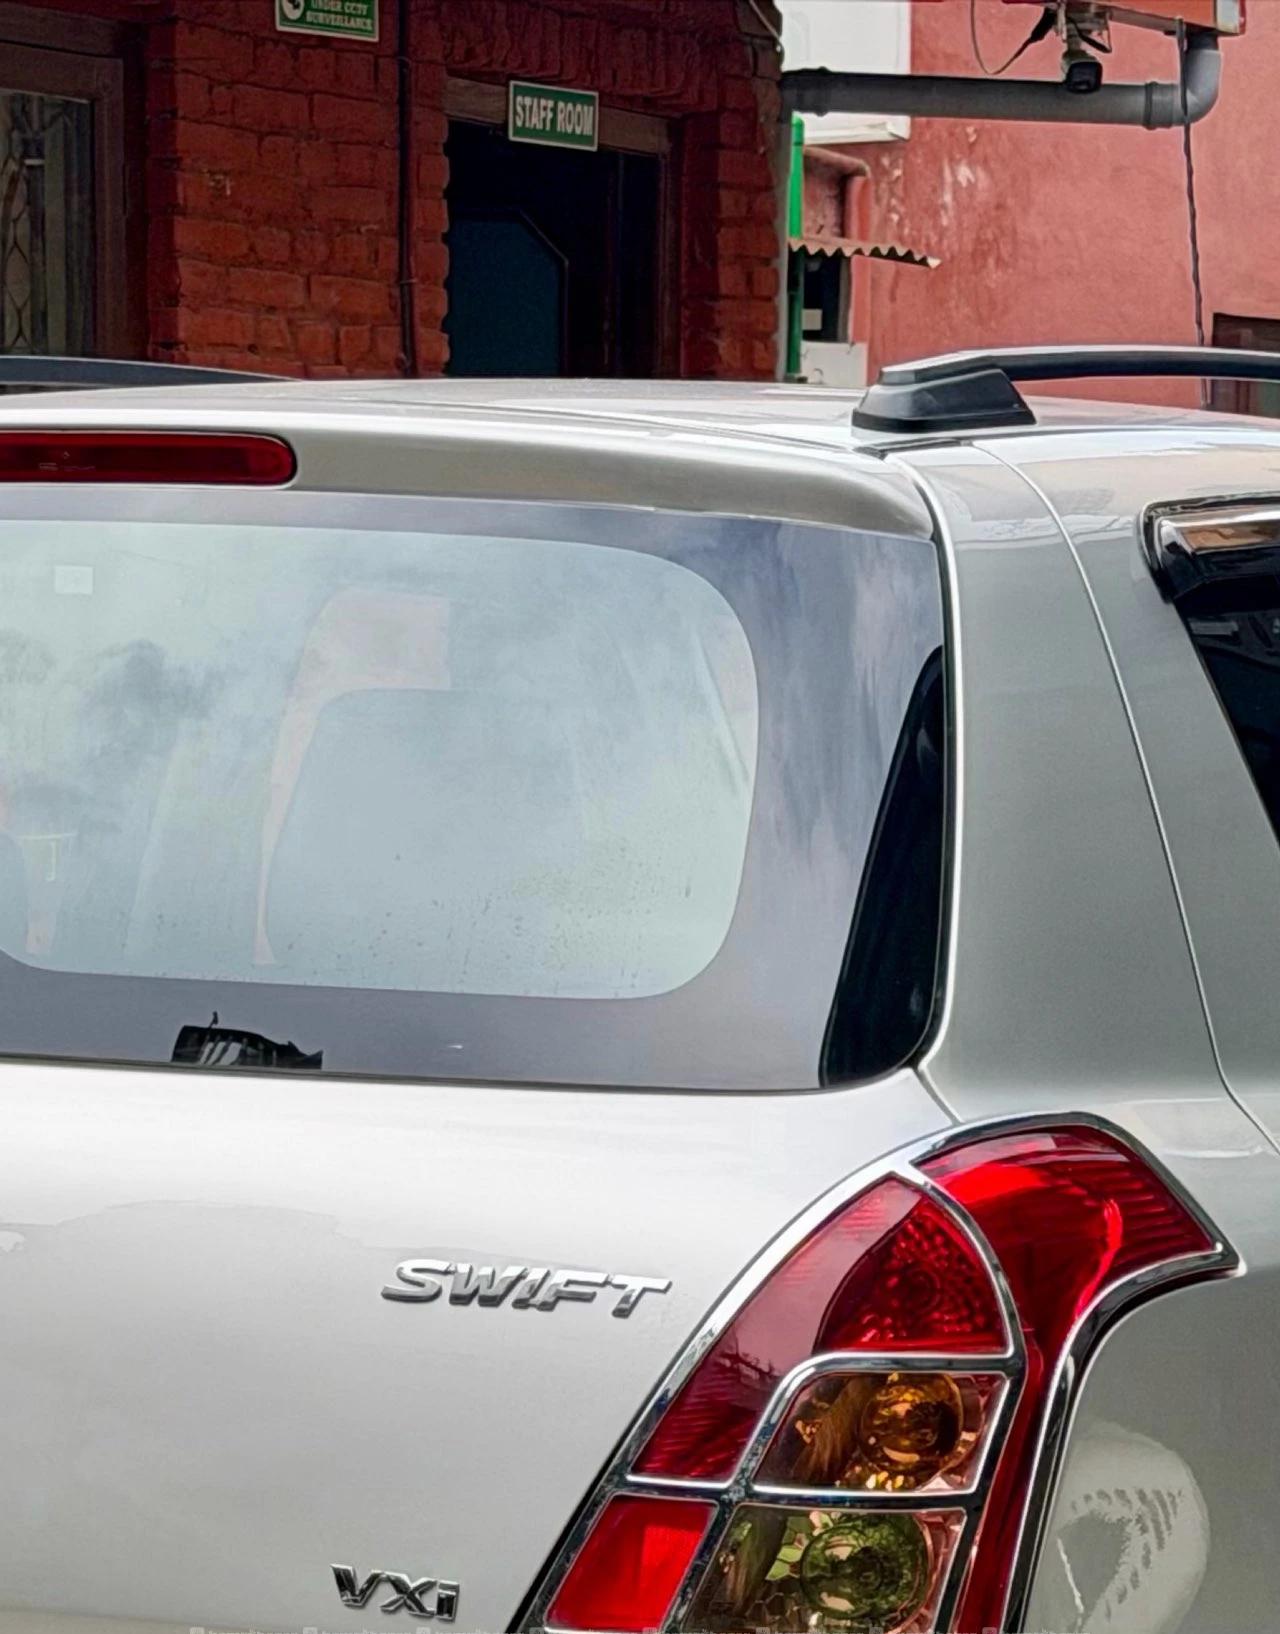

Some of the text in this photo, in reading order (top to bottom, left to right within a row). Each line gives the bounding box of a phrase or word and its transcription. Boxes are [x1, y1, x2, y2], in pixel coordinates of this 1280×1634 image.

[516, 95, 594, 136] STAFF ROOM
[381, 1258, 672, 1318] SWIFT
